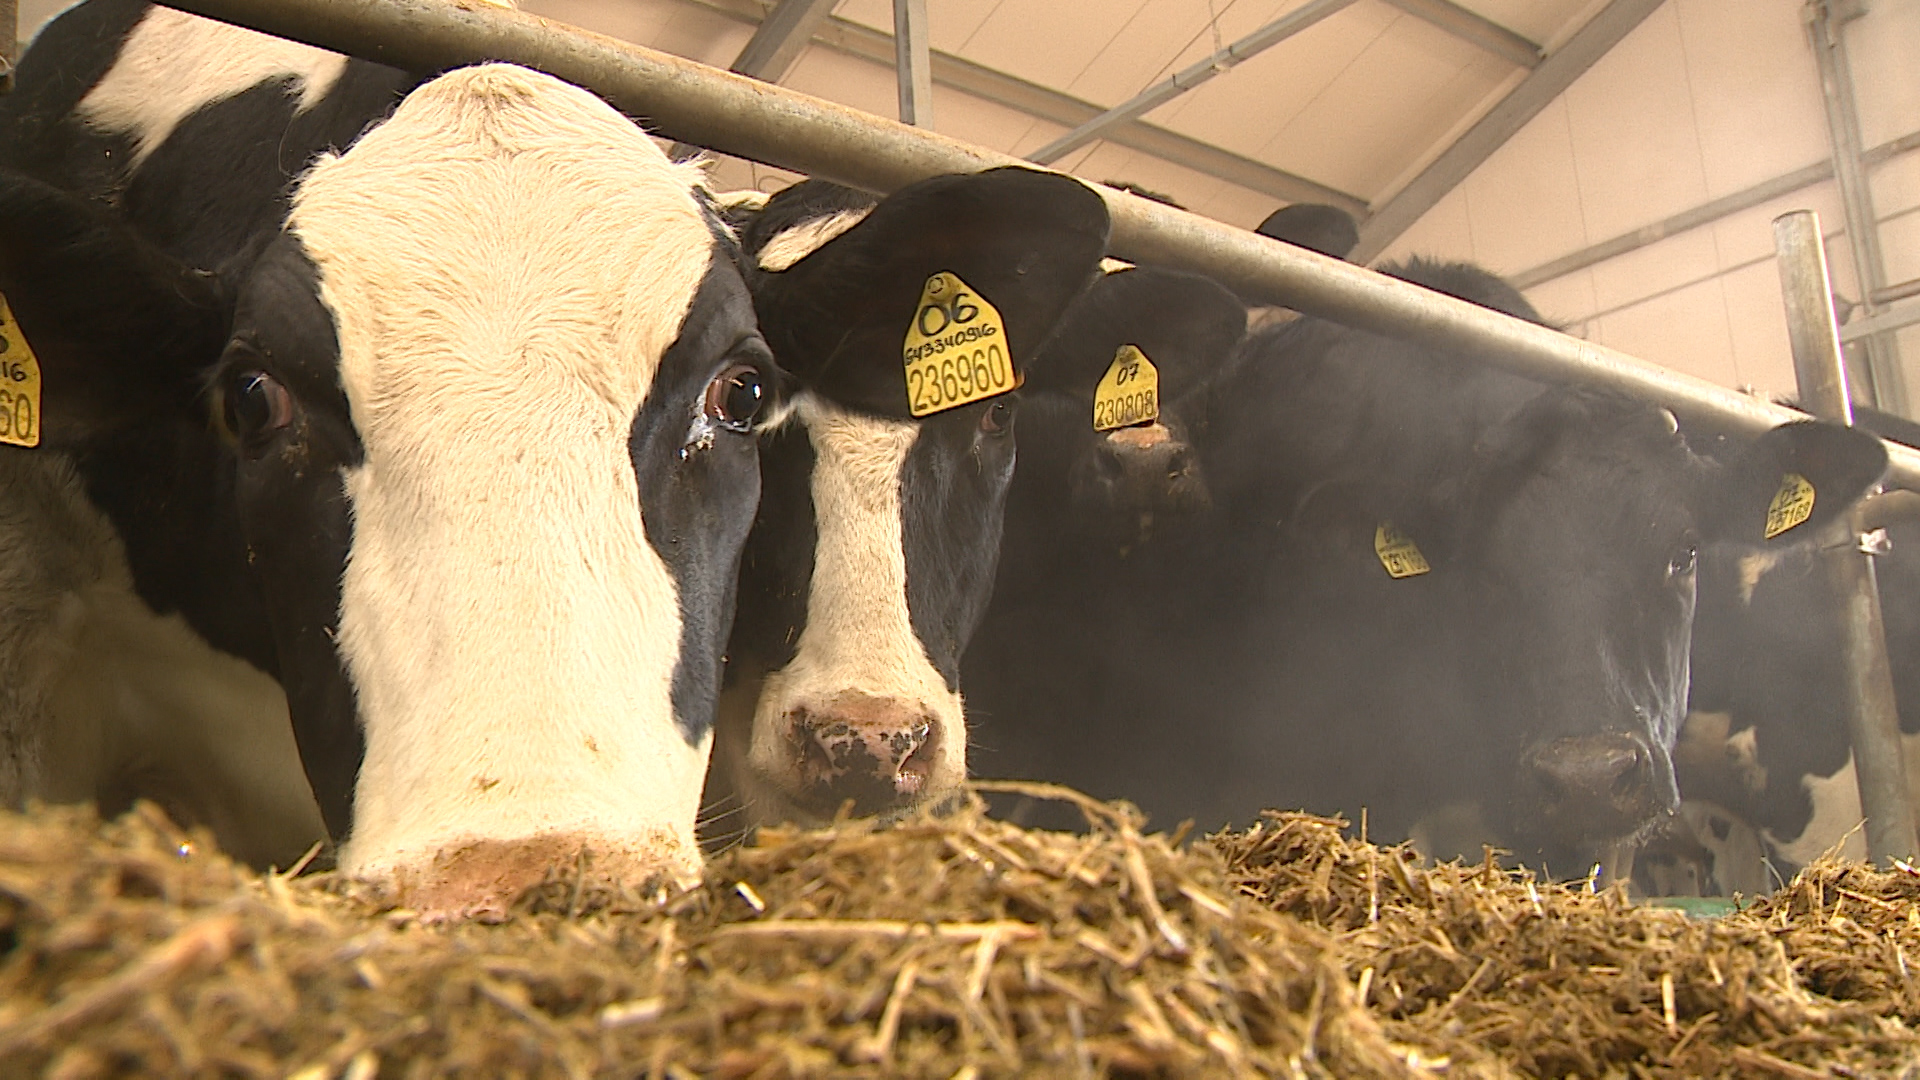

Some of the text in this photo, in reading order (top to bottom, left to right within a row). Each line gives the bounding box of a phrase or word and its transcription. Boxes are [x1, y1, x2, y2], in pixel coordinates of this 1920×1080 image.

[918, 292, 979, 338] 06
[909, 343, 1005, 412] 236960
[1116, 362, 1140, 386] 07
[1096, 389, 1154, 428] 230808
